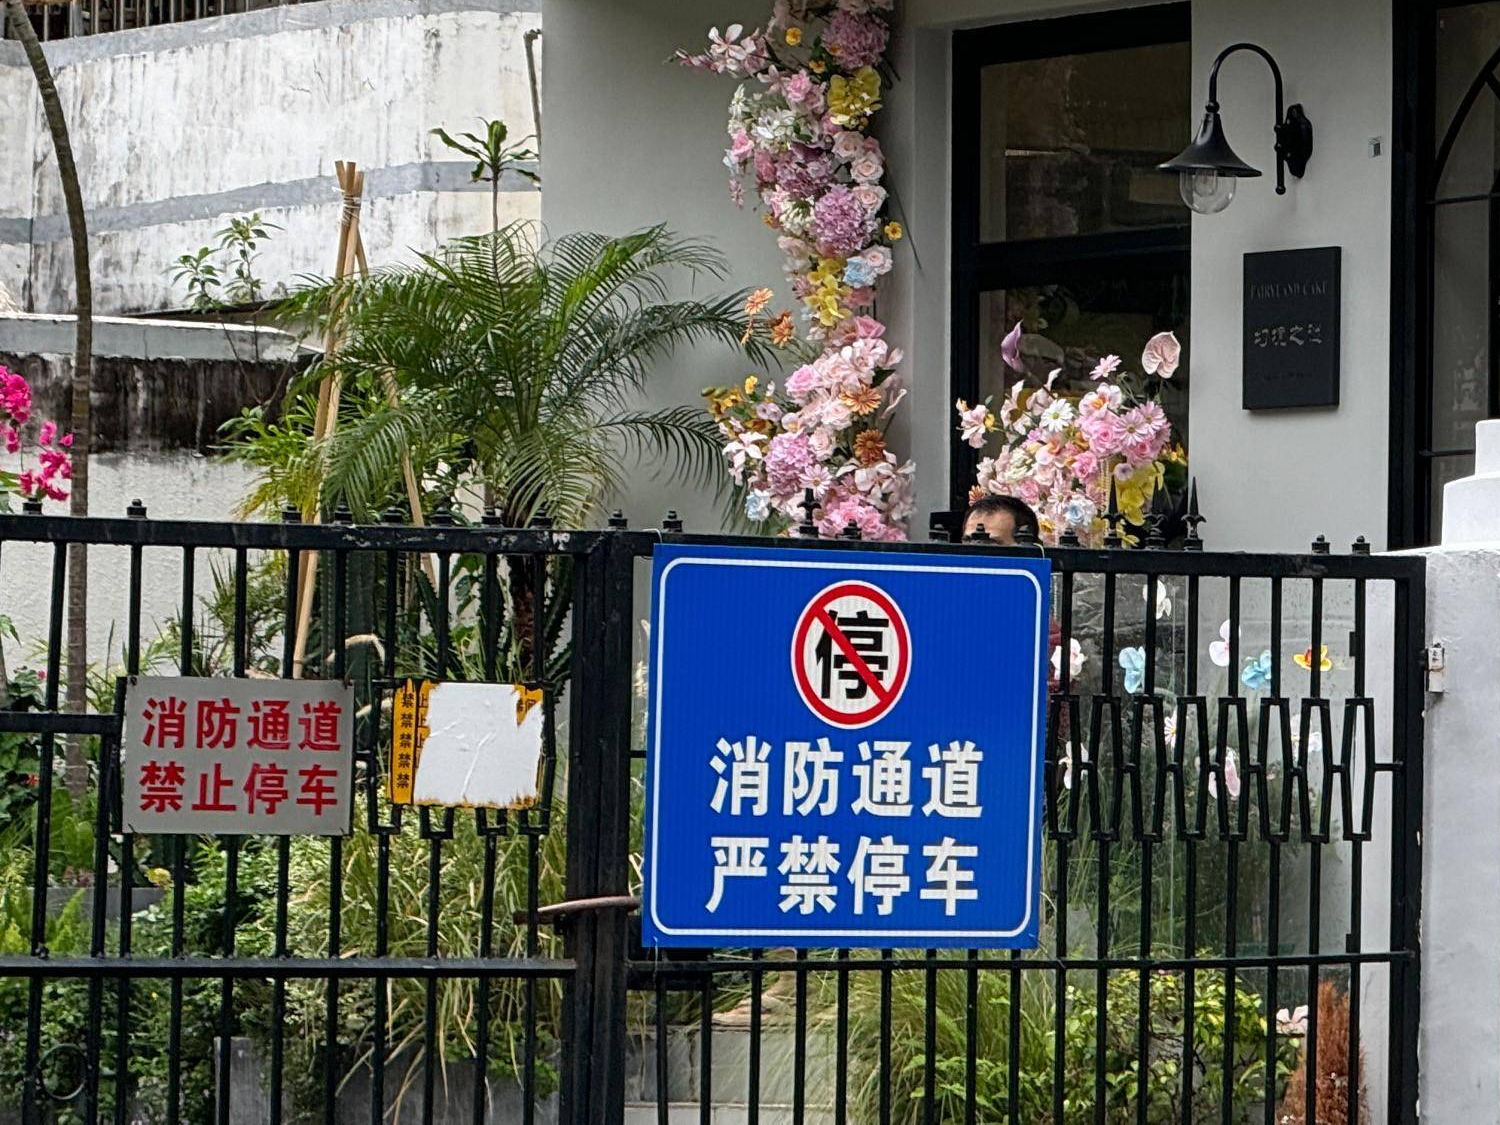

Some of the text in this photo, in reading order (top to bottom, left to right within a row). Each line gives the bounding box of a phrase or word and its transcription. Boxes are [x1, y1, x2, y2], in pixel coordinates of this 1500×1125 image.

[815, 610, 889, 699] 停
[142, 696, 342, 752] 消防通道
[139, 760, 338, 815] 禁止停车
[709, 736, 984, 818] 消防通道
[705, 835, 979, 916] 严禁停车
